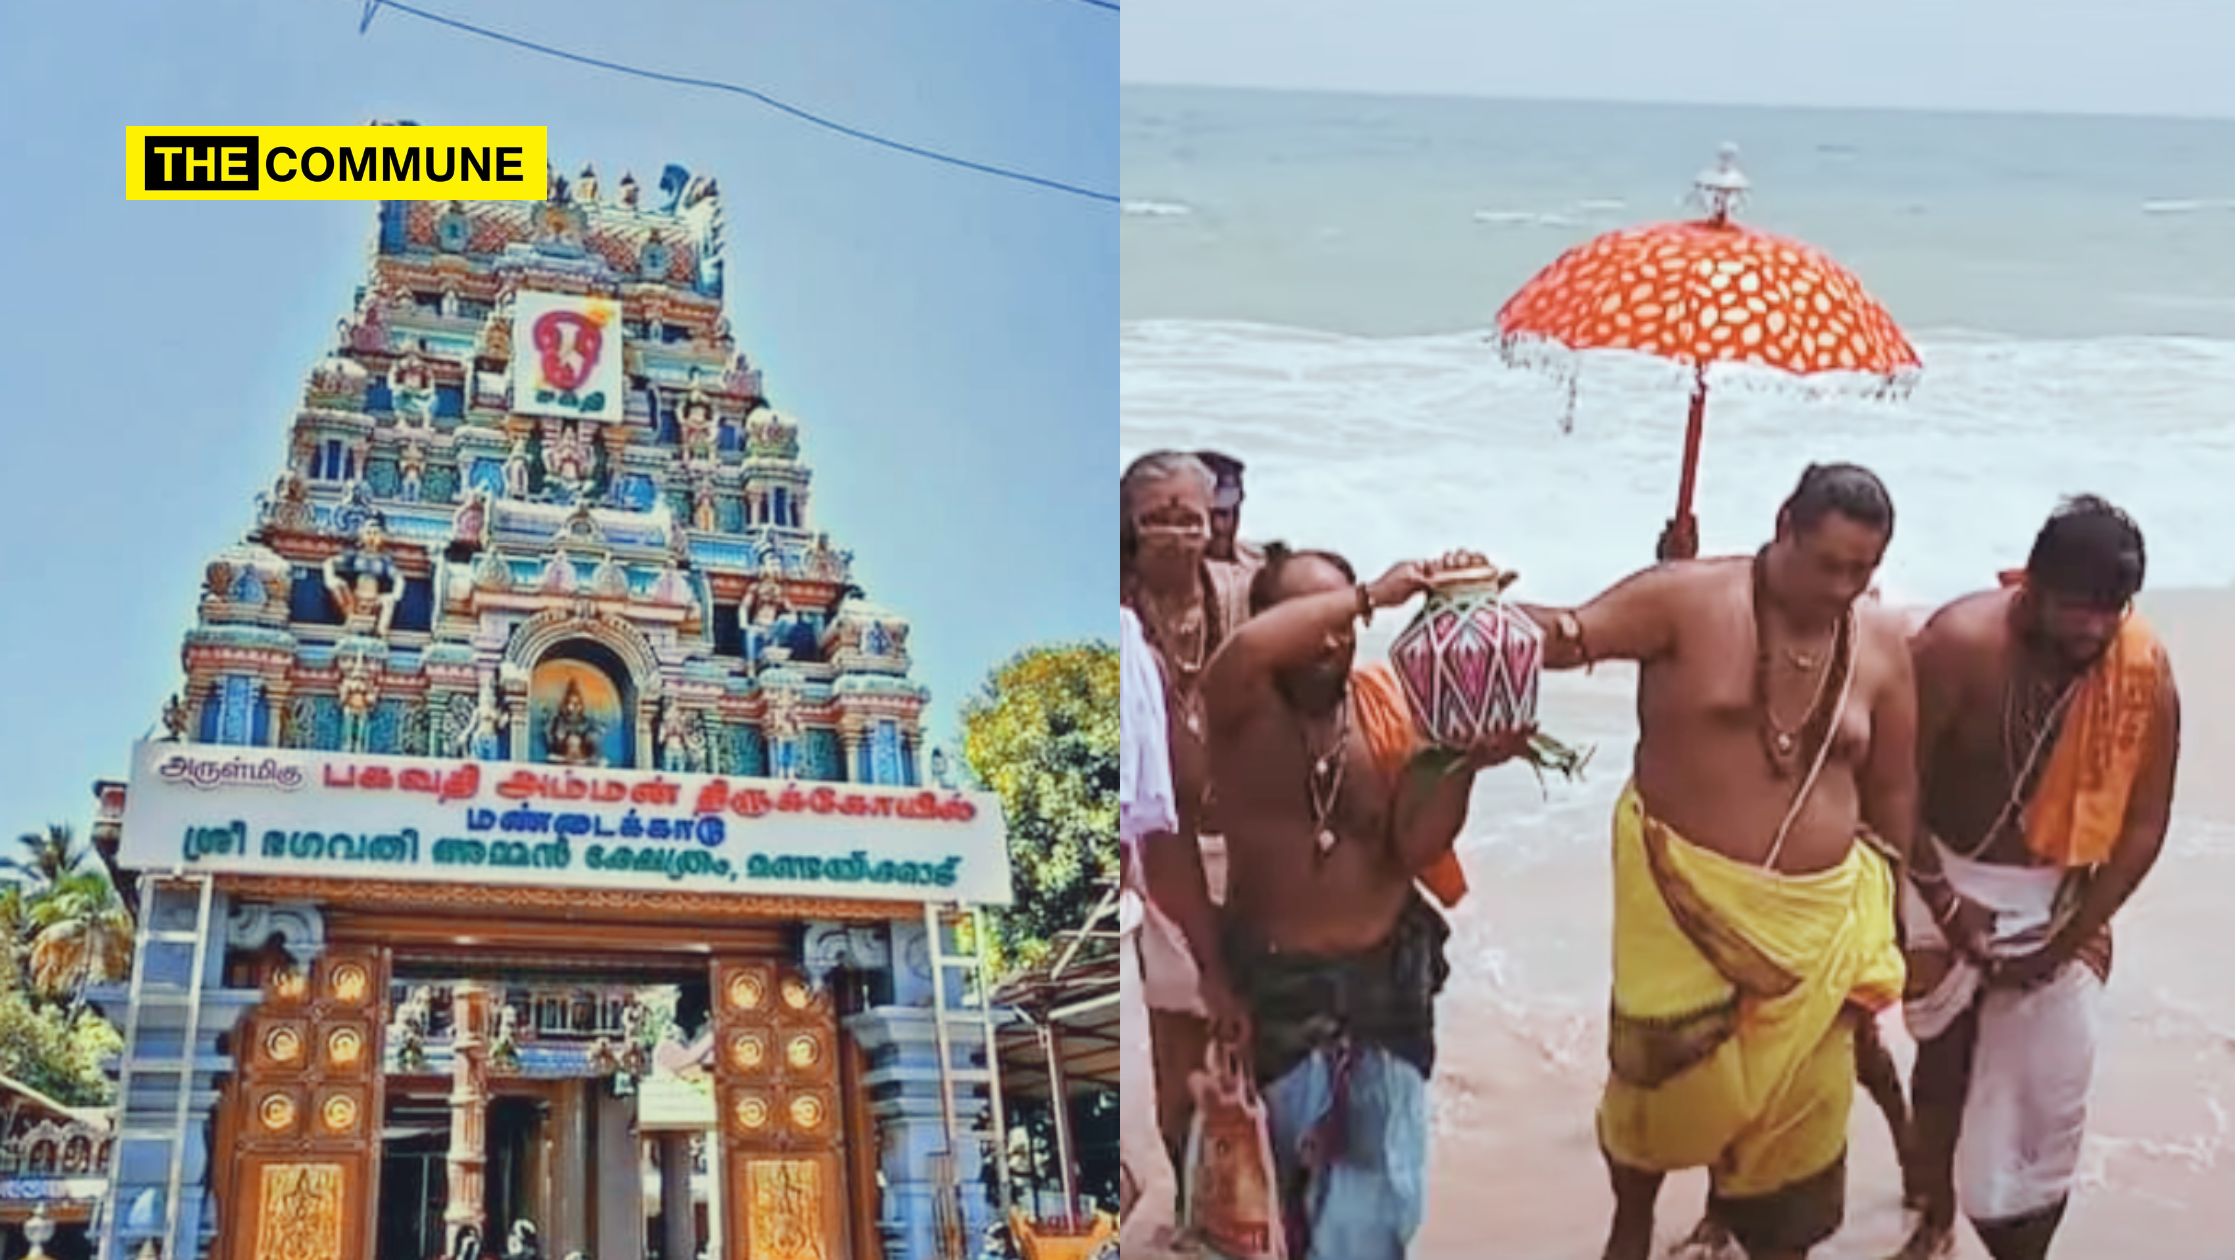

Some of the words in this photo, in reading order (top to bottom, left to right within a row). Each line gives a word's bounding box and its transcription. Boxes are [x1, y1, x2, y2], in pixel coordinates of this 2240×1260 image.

[159, 755, 303, 787] அருள்மிகு
[323, 762, 481, 804] பகவதி
[496, 768, 681, 804] அம்மன்
[693, 778, 977, 822] திருக்கோயில்
[182, 820, 247, 862] ശ്രീ
[261, 828, 419, 864] ഭഗവതി
[466, 801, 726, 847] மண்டைக்காடு
